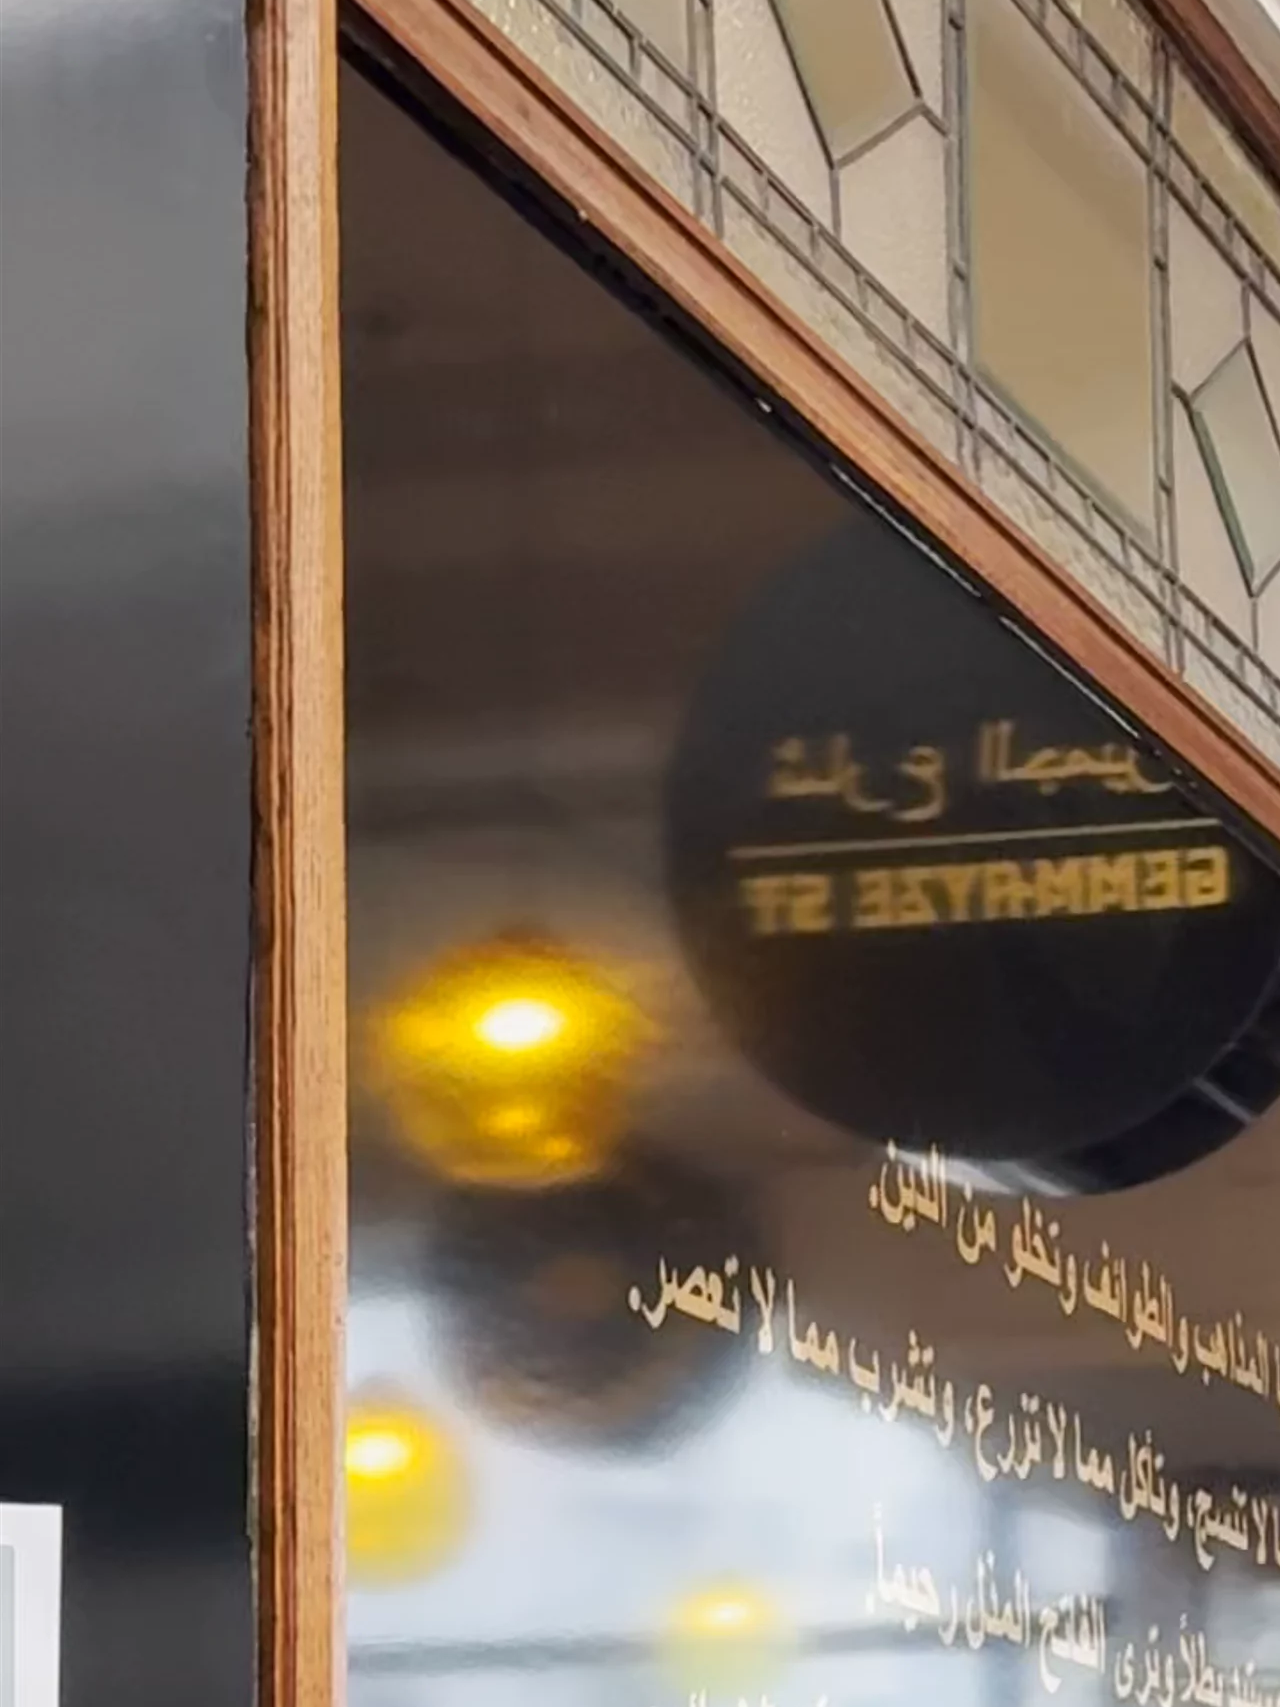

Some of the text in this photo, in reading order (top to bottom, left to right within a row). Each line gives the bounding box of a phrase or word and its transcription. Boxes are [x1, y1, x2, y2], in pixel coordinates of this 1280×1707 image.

[957, 1182, 996, 1264] من
[751, 1266, 776, 1354] لا
[787, 1278, 840, 1375] مما
[1047, 1403, 1067, 1479] لا
[1074, 1412, 1115, 1494] مما
